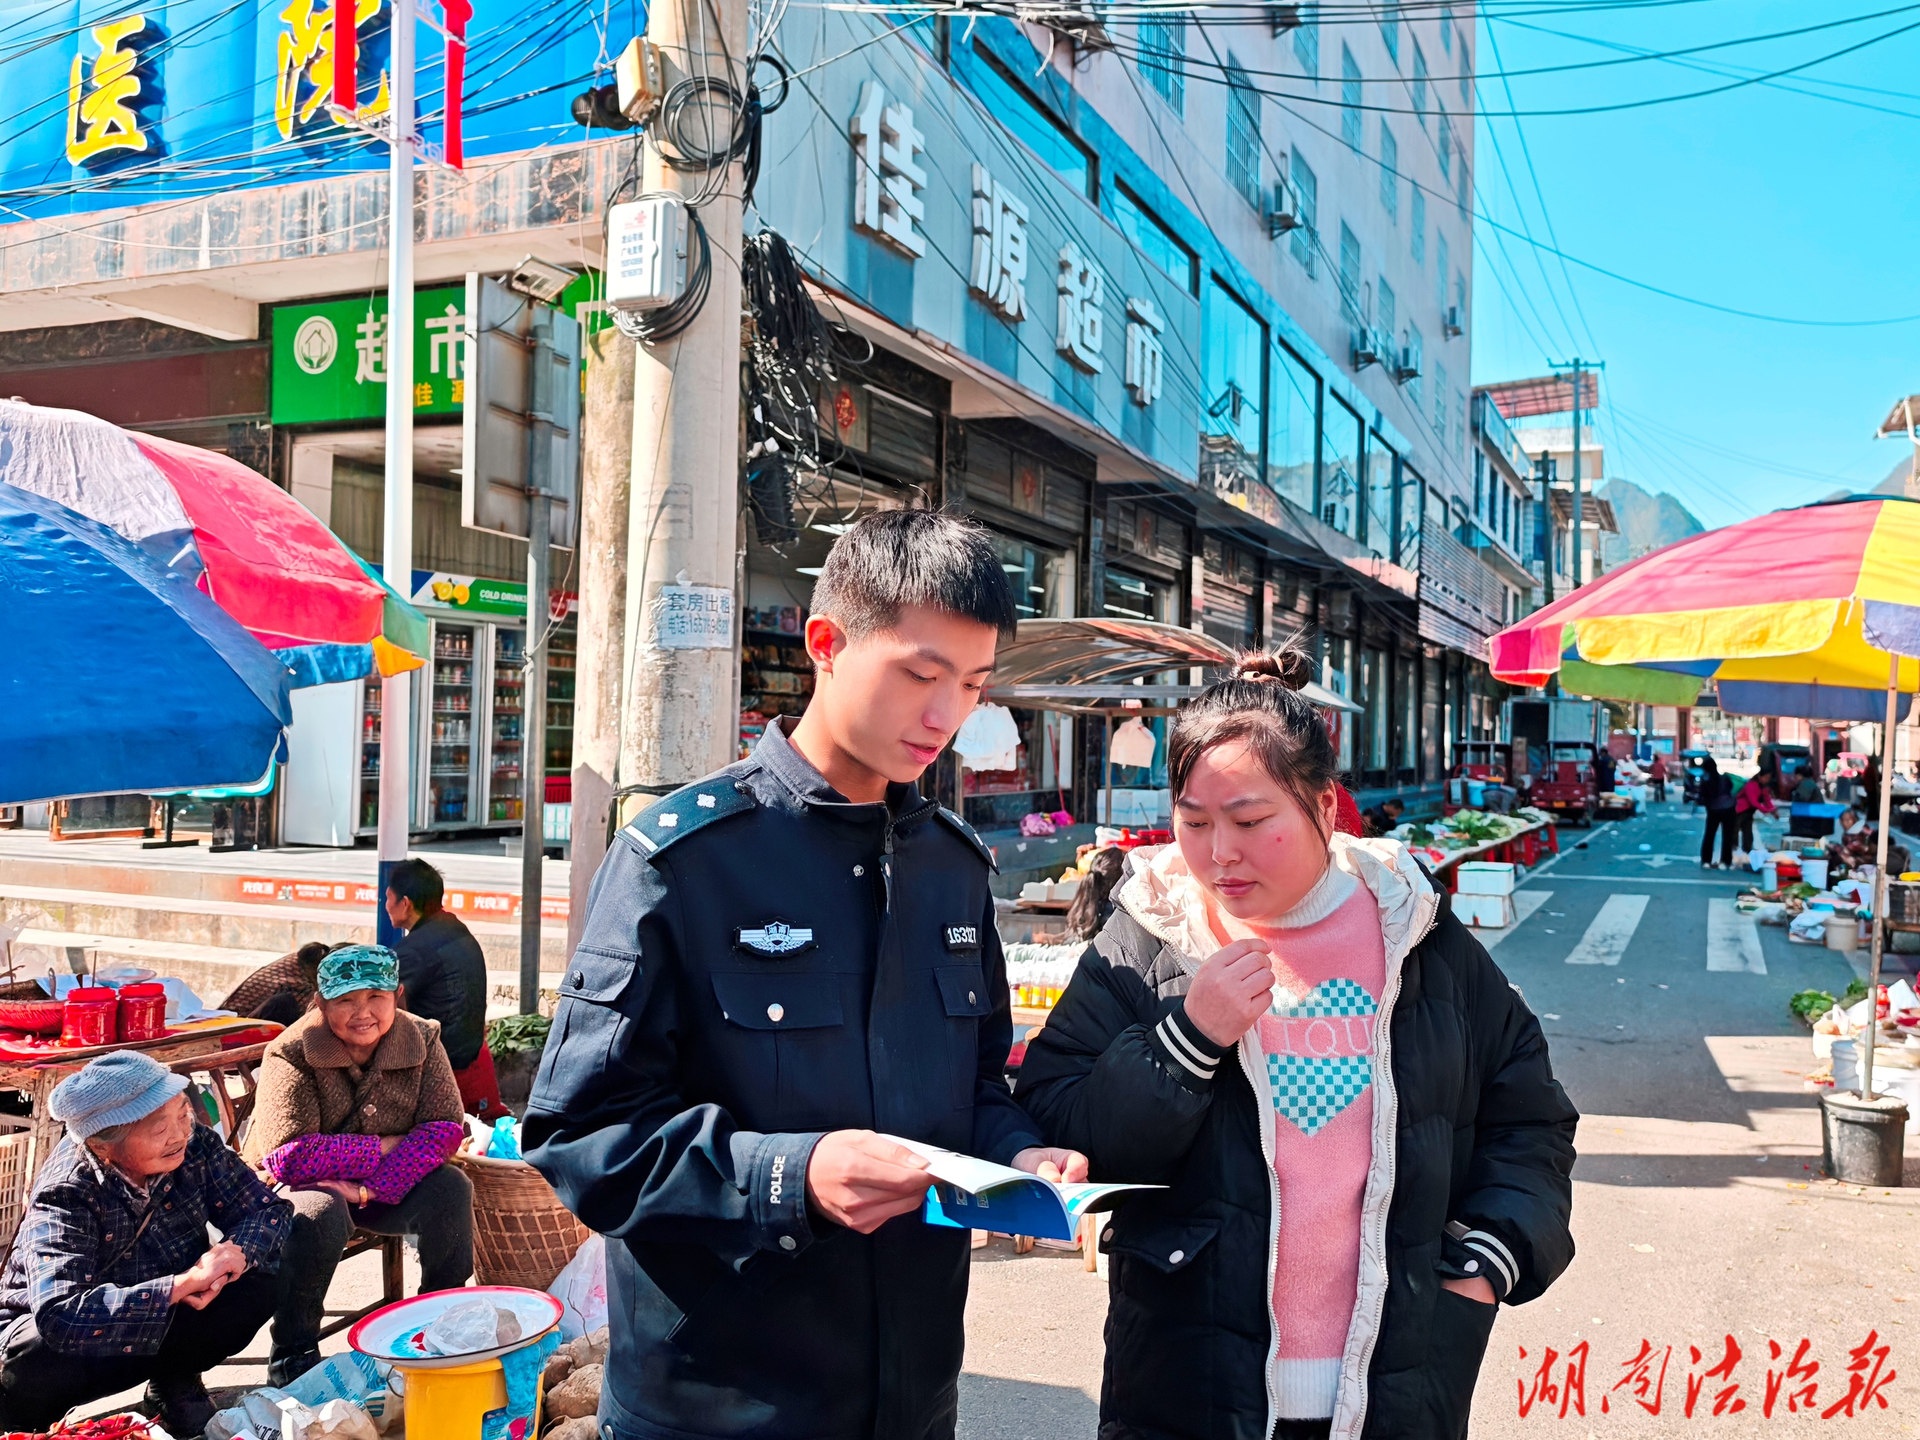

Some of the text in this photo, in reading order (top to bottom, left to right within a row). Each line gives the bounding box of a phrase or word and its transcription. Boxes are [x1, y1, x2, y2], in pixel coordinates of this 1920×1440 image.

[850, 80, 1165, 406] 佳源超市
[479, 589, 501, 600] COLD
[667, 592, 730, 614] 套房出租
[770, 1155, 786, 1205] POLICE
